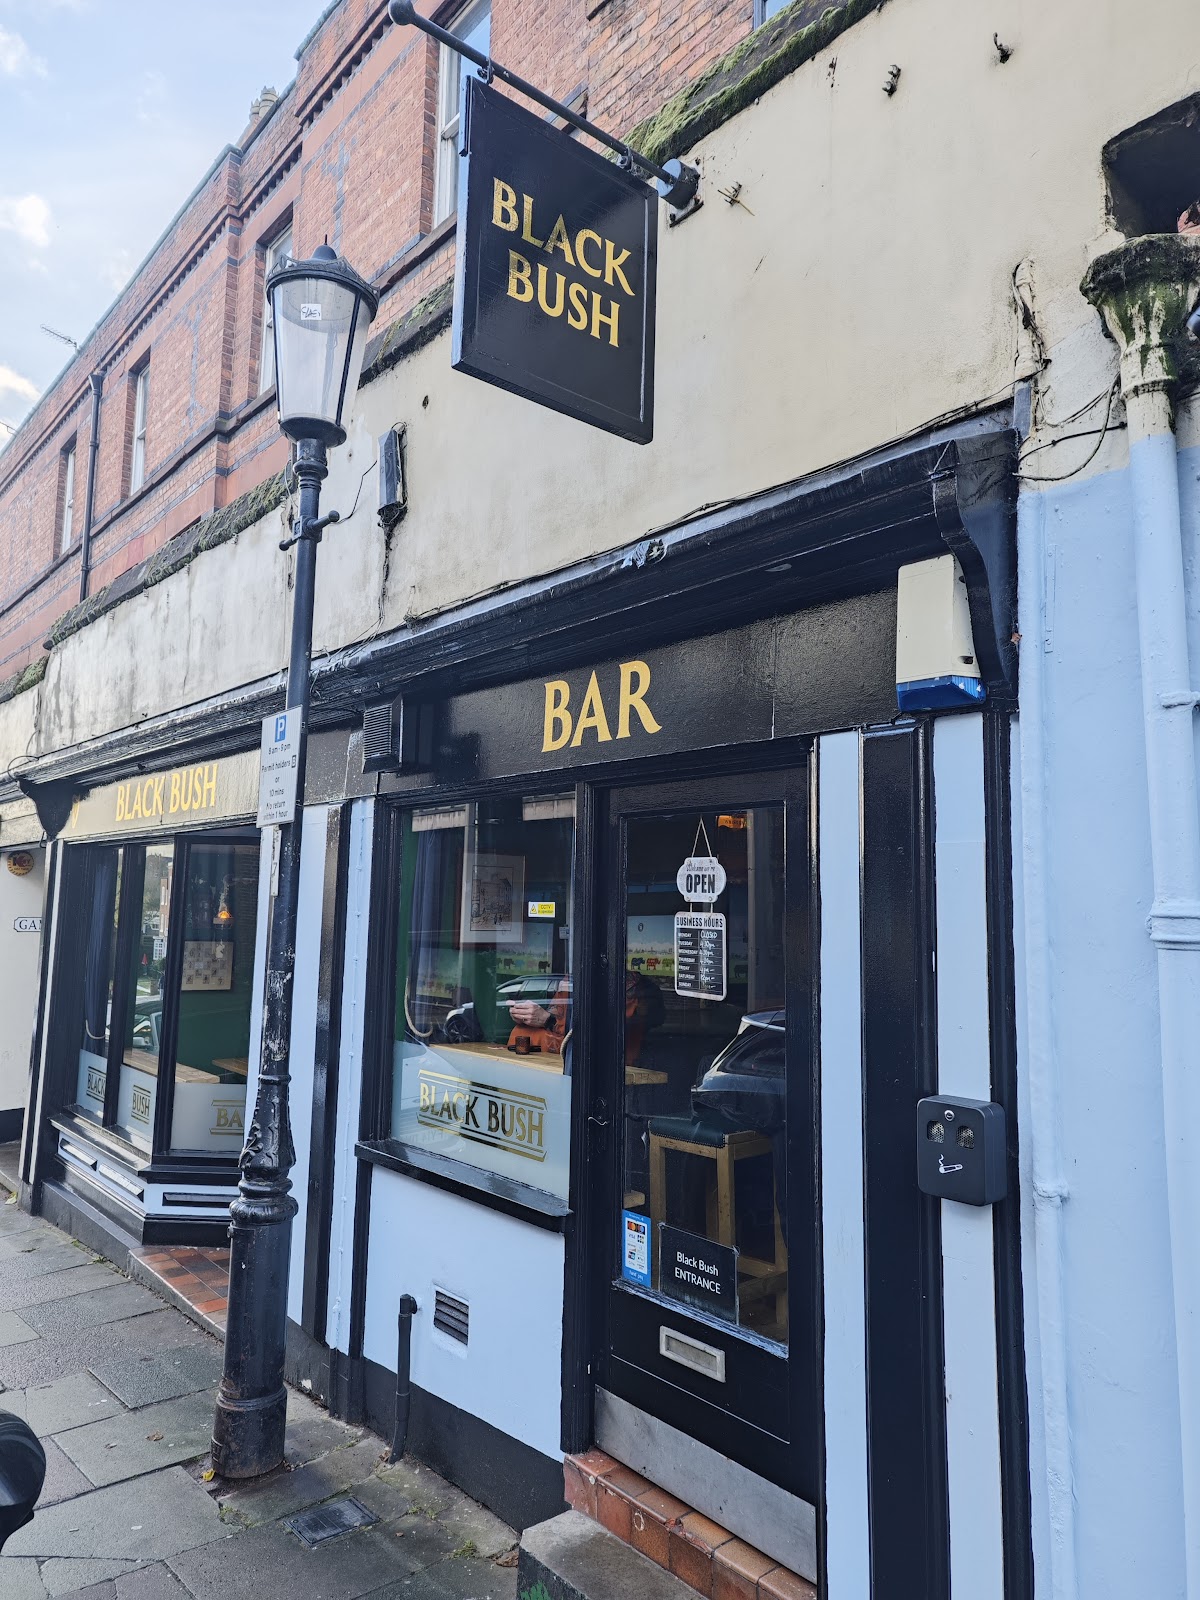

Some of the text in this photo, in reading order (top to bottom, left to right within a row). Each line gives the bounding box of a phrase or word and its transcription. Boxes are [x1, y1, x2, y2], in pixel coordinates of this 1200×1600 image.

[492, 177, 635, 296] BLACK
[507, 249, 620, 347] BUSH
[541, 660, 662, 752] BAR
[261, 763, 275, 773] Permit
[275, 759, 291, 770] holders
[115, 763, 219, 821] BLACK BUSH
[685, 873, 716, 894] OPEN
[676, 916, 723, 928] BUSINESS HOURS
[700, 930, 718, 939] CLOSED
[87, 1073, 106, 1096] BLACK
[132, 1093, 151, 1117] BUSH
[419, 1082, 544, 1147] BLACK BUSH
[676, 1251, 719, 1277] Black Bush
[674, 1266, 721, 1295] ENTRANCE
